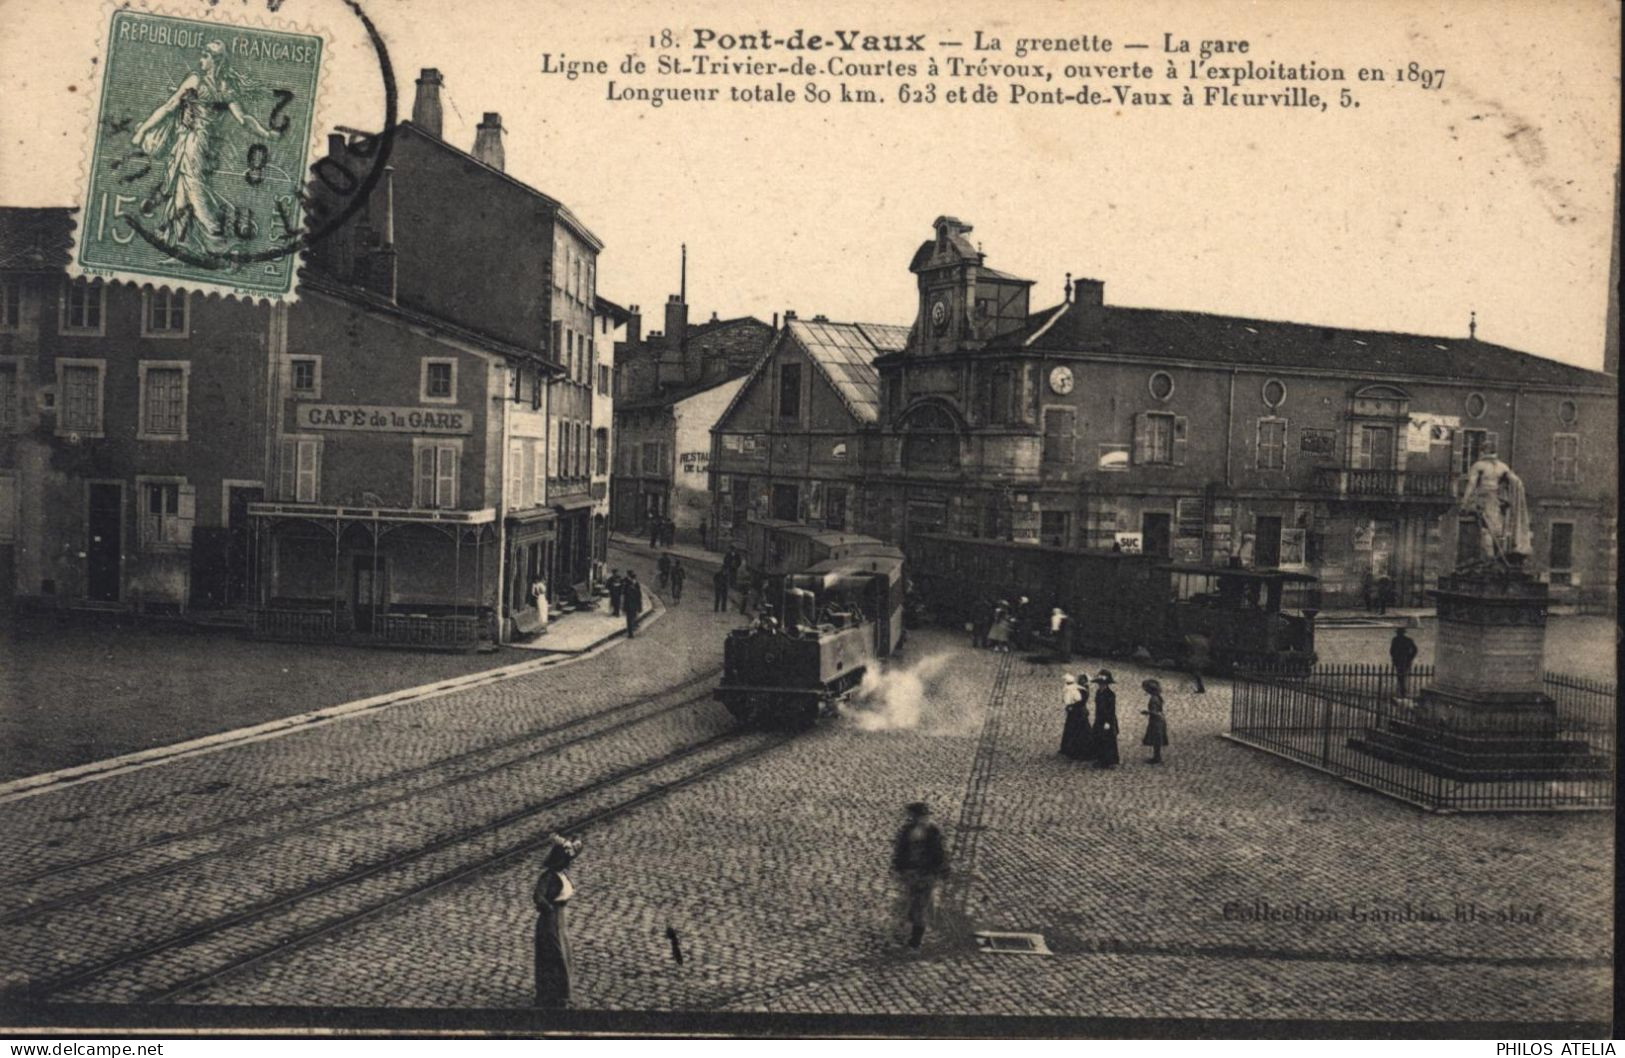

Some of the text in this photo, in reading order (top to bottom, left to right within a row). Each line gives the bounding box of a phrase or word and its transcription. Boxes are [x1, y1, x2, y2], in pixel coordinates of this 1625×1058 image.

[308, 408, 463, 429] CAFÉ de la GARE
